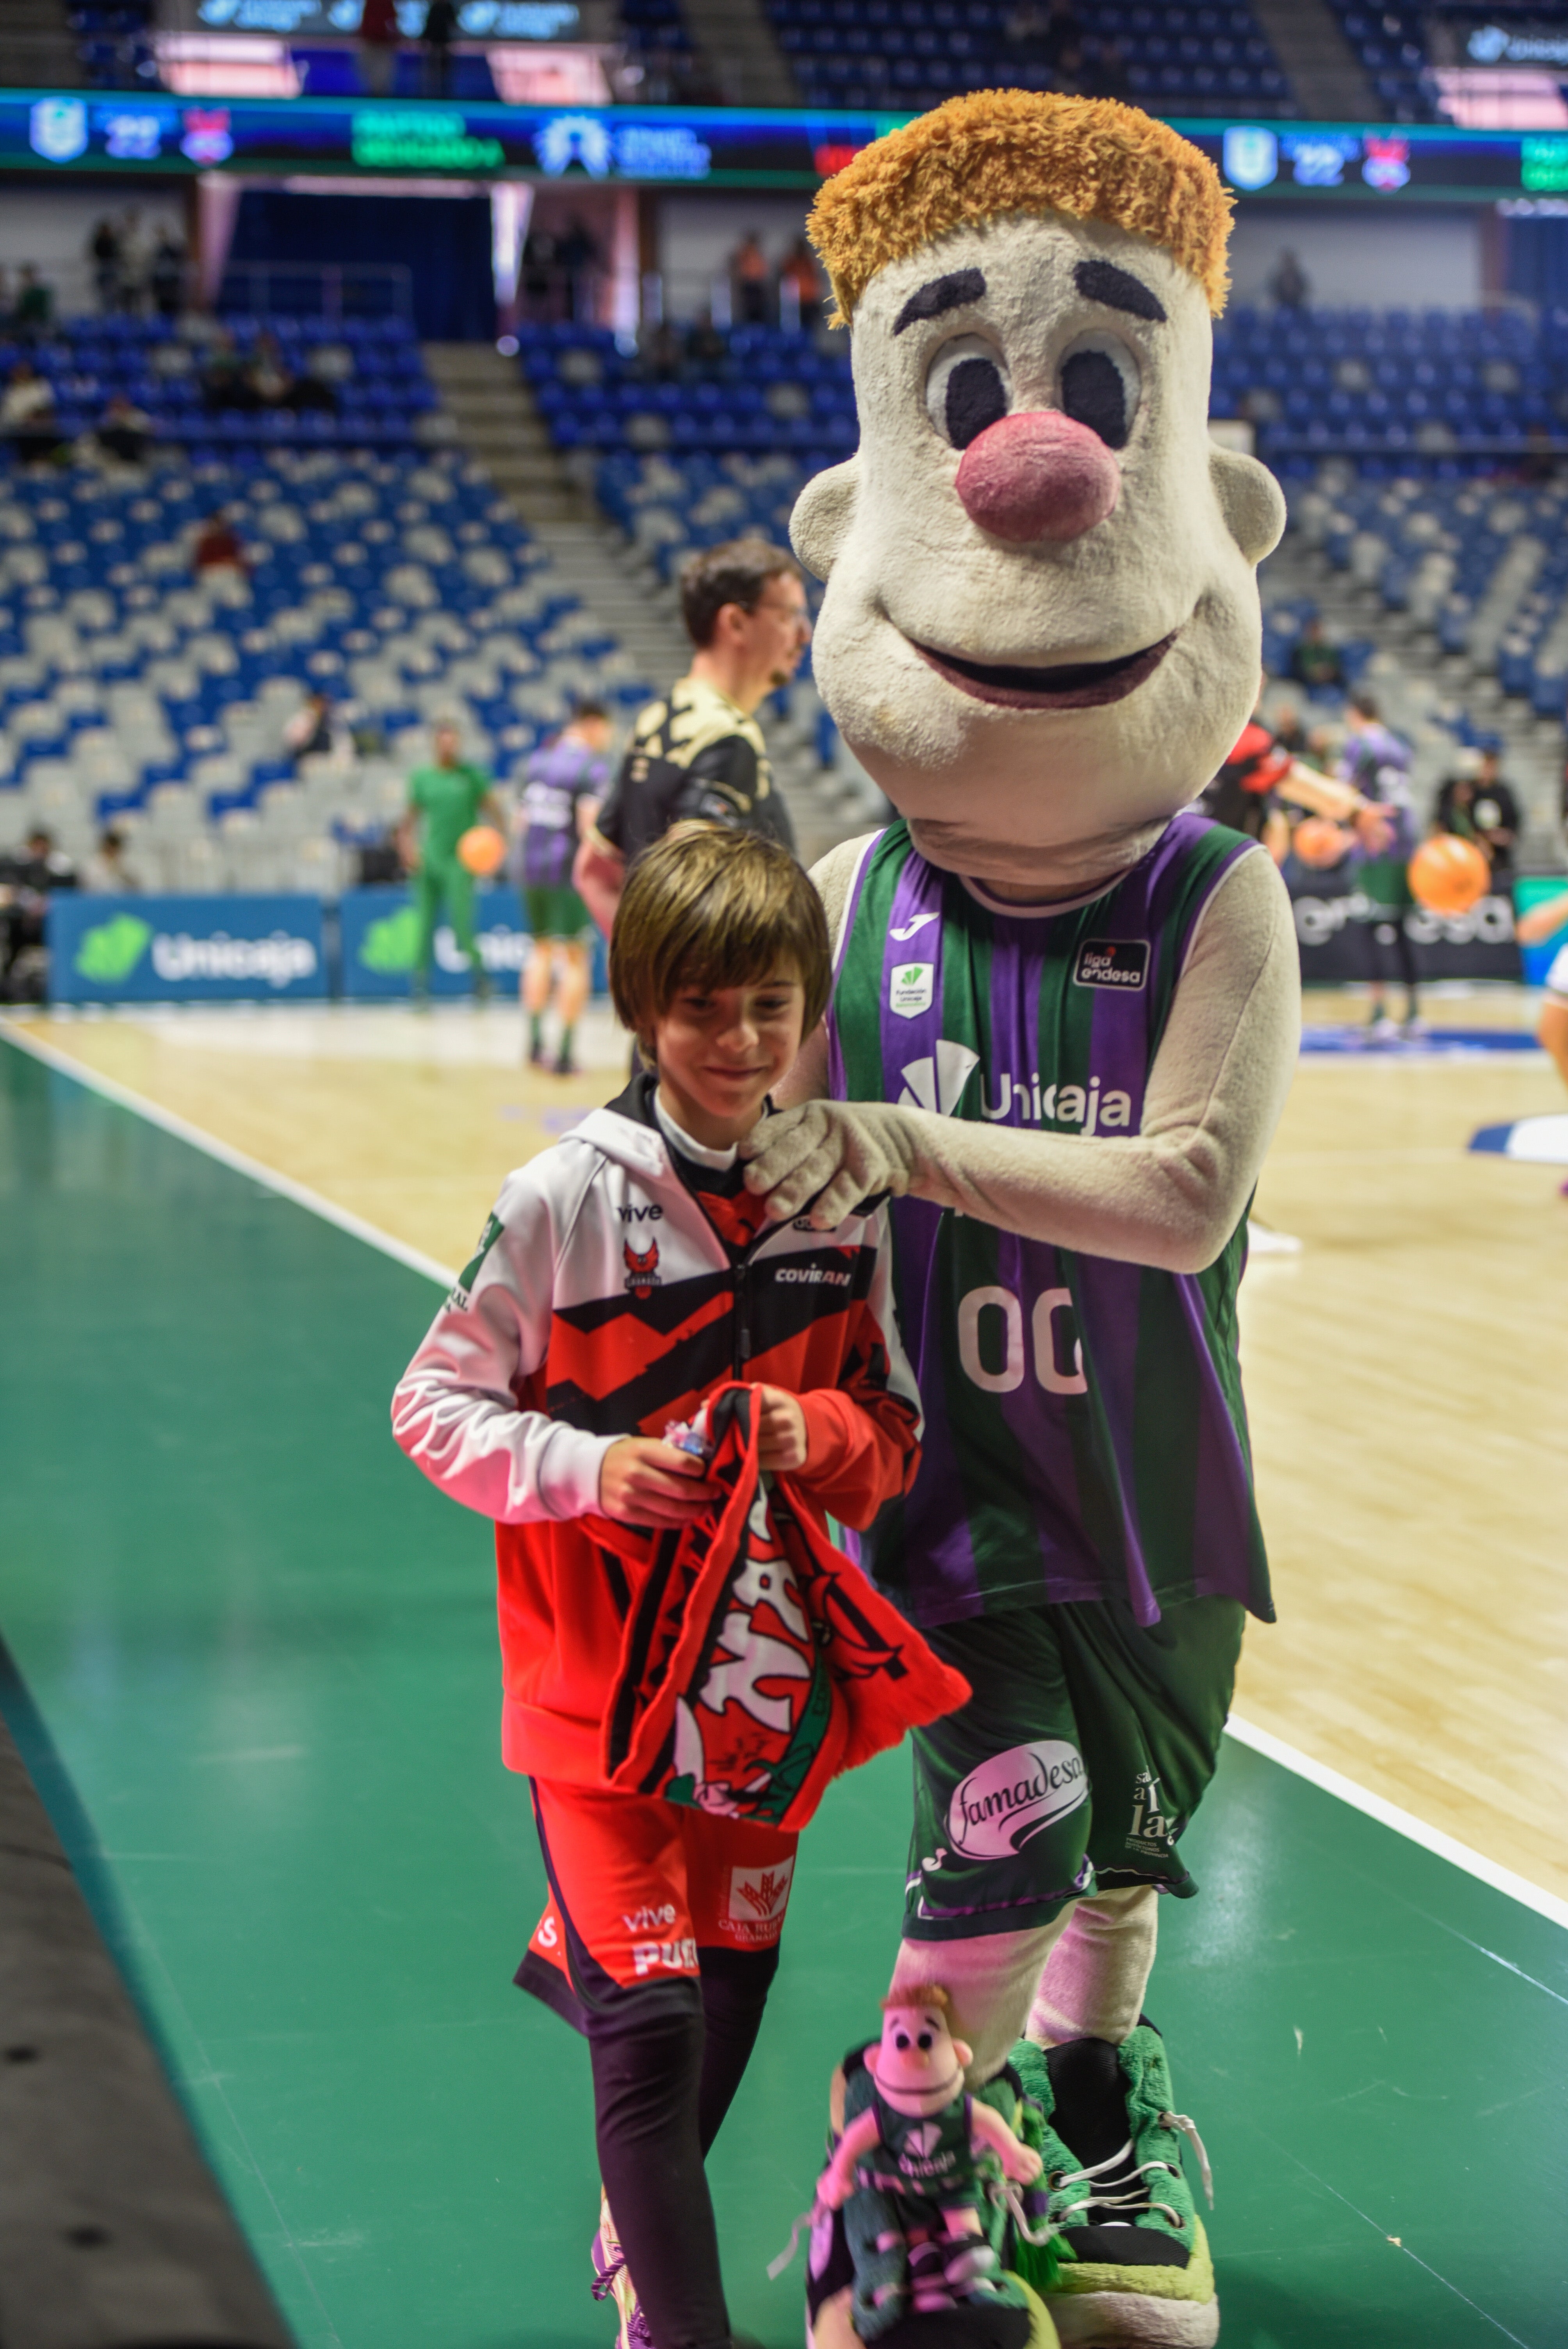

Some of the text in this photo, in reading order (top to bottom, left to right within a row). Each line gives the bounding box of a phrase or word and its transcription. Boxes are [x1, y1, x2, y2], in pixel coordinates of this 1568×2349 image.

[1084, 952, 1112, 968] liga
[1081, 967, 1141, 984] endesa
[980, 1072, 1131, 1137] Unicaja
[617, 1204, 663, 1223] vive
[622, 1903, 676, 1933] vive
